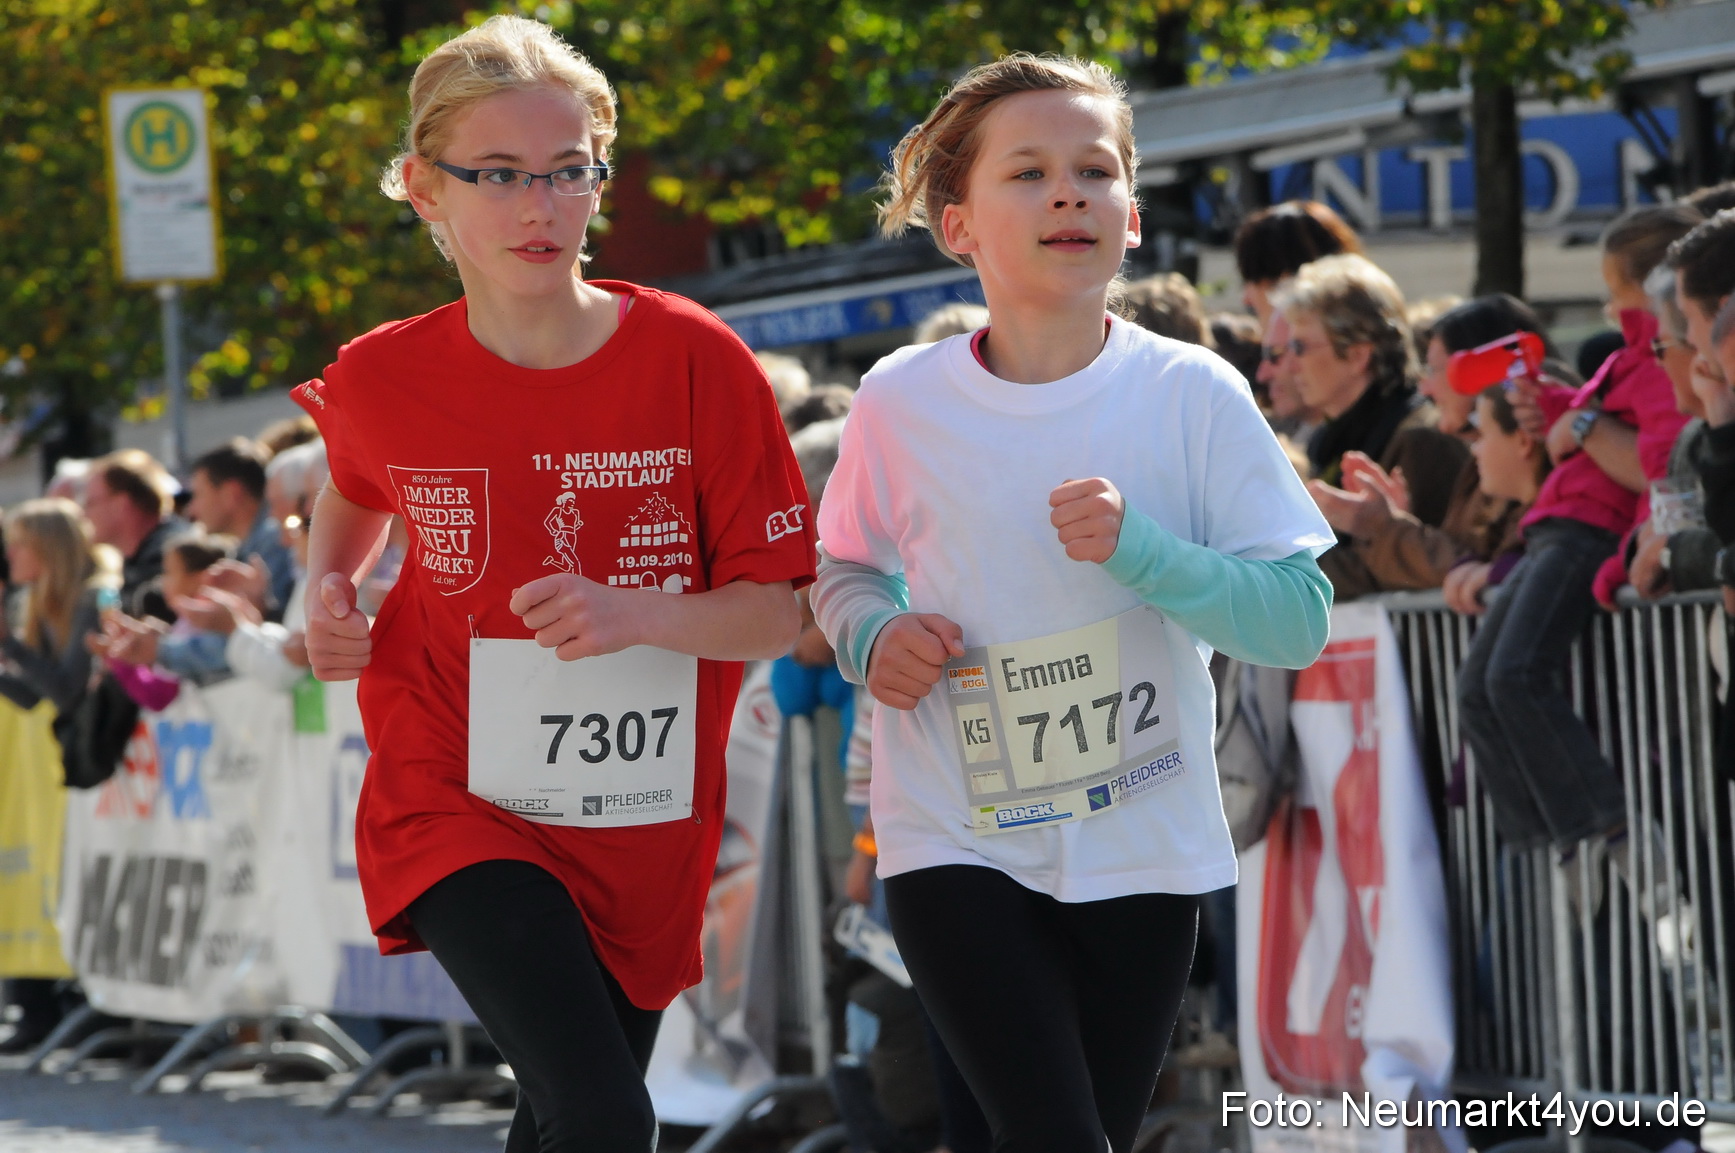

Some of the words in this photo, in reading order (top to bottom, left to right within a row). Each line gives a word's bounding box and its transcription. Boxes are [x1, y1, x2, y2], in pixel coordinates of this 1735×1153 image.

[142, 117, 177, 156] H
[532, 454, 561, 470] 11.
[412, 475, 428, 484] 850
[428, 475, 453, 484] Jahre
[560, 466, 675, 489] STADTLAUF
[403, 485, 471, 505] IMMER
[406, 504, 477, 526] WIEDER
[415, 525, 472, 555] NEU
[422, 551, 475, 575] MARKT
[617, 552, 693, 569] 19.09.2010
[1001, 653, 1094, 693] Emma
[963, 718, 991, 746] K5
[1017, 681, 1160, 763] 7172
[540, 706, 679, 764] 7307
[1111, 752, 1183, 794] PFLEIDERER
[1114, 767, 1186, 803] AKTIENGESELLSCHAFT
[493, 799, 549, 810] BOCK
[605, 789, 673, 807] PFLEIDERER
[605, 803, 673, 815] AKTIENGESELLSCHAFT
[996, 802, 1055, 823] BOCK
